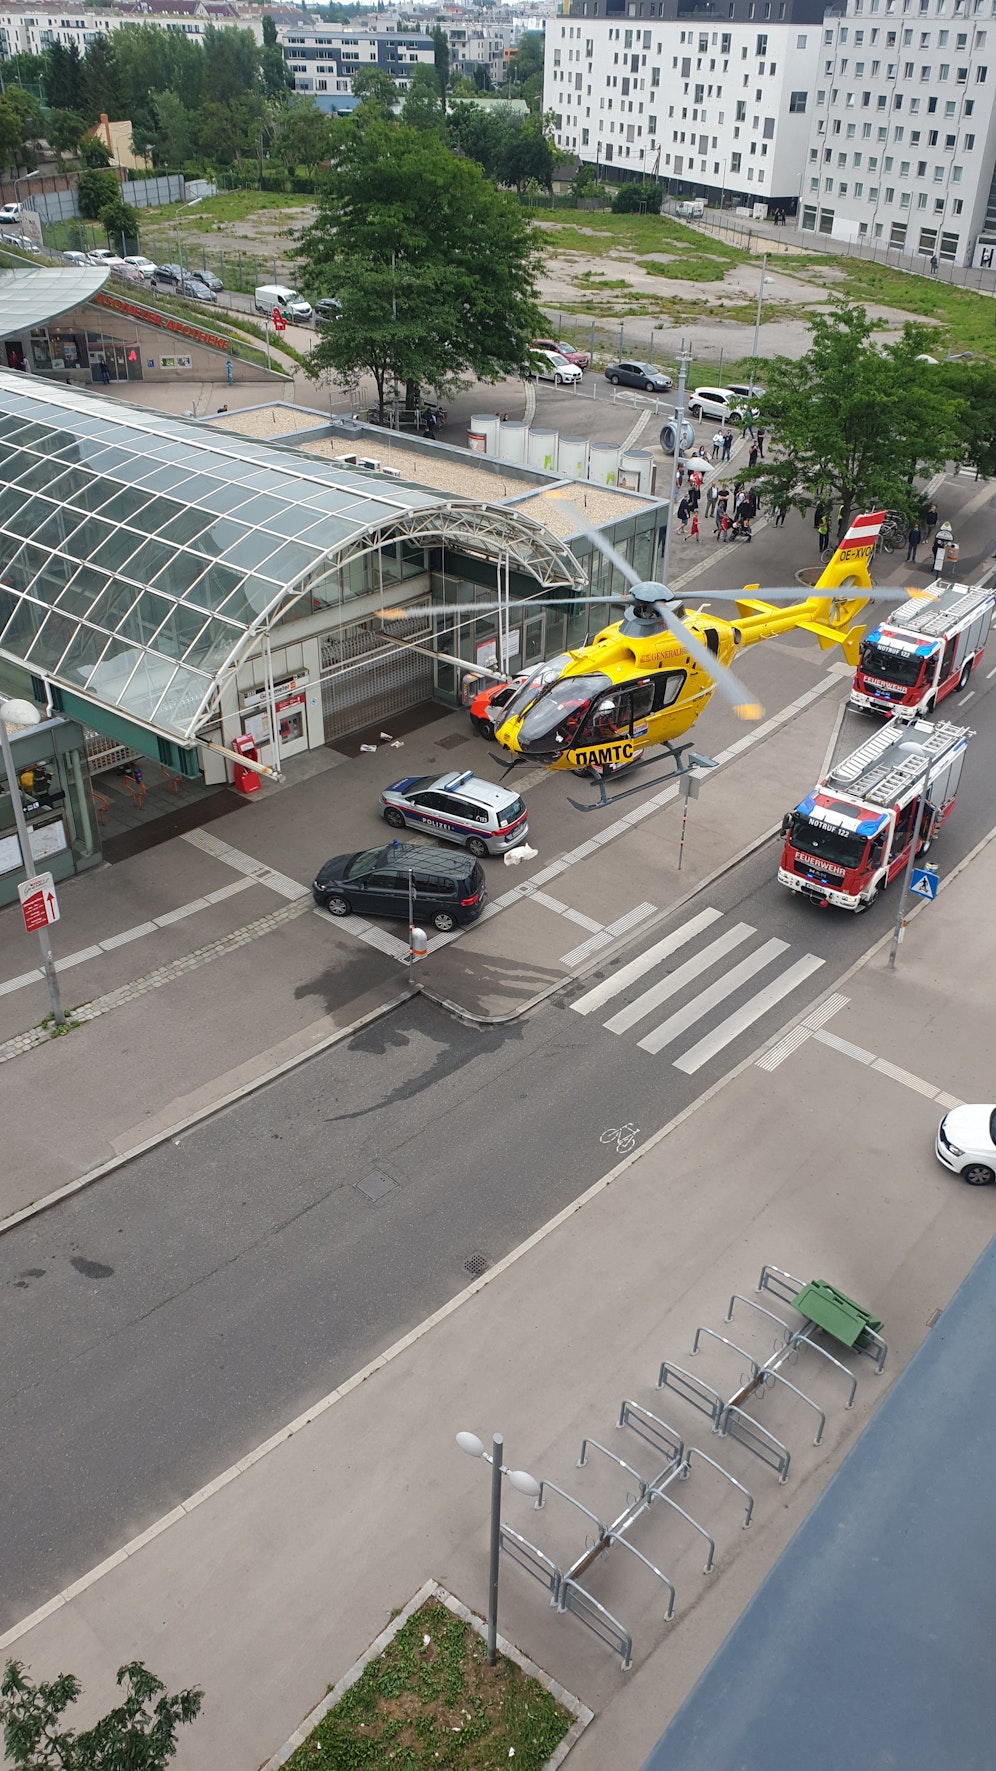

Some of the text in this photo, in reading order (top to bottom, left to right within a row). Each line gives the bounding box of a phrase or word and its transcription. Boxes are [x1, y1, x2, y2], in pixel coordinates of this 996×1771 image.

[877, 644, 900, 655] NOTRUF
[863, 675, 907, 694] FEUERWEHR
[422, 817, 451, 831] POLIZEI
[808, 818, 850, 838] NOTRUF 122
[794, 851, 846, 876] FEUERWEHR
